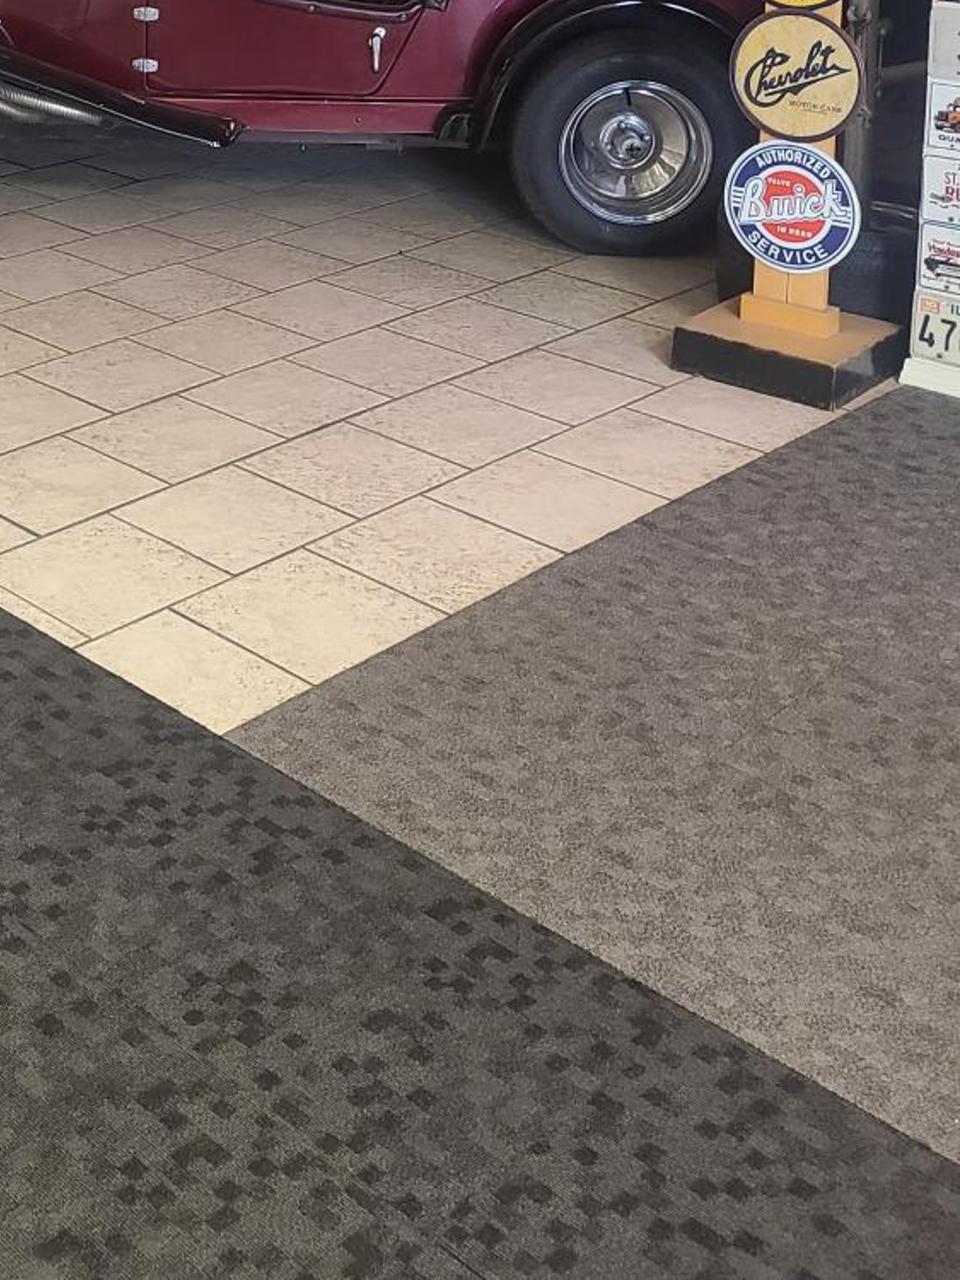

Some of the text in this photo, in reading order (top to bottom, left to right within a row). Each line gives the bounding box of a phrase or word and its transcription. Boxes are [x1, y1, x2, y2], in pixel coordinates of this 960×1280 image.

[744, 40, 851, 108] Chevrolet
[755, 149, 831, 179] AUTHORIZED
[740, 175, 848, 224] Buick
[748, 231, 828, 264] SERVICE
[919, 314, 957, 352] 47
